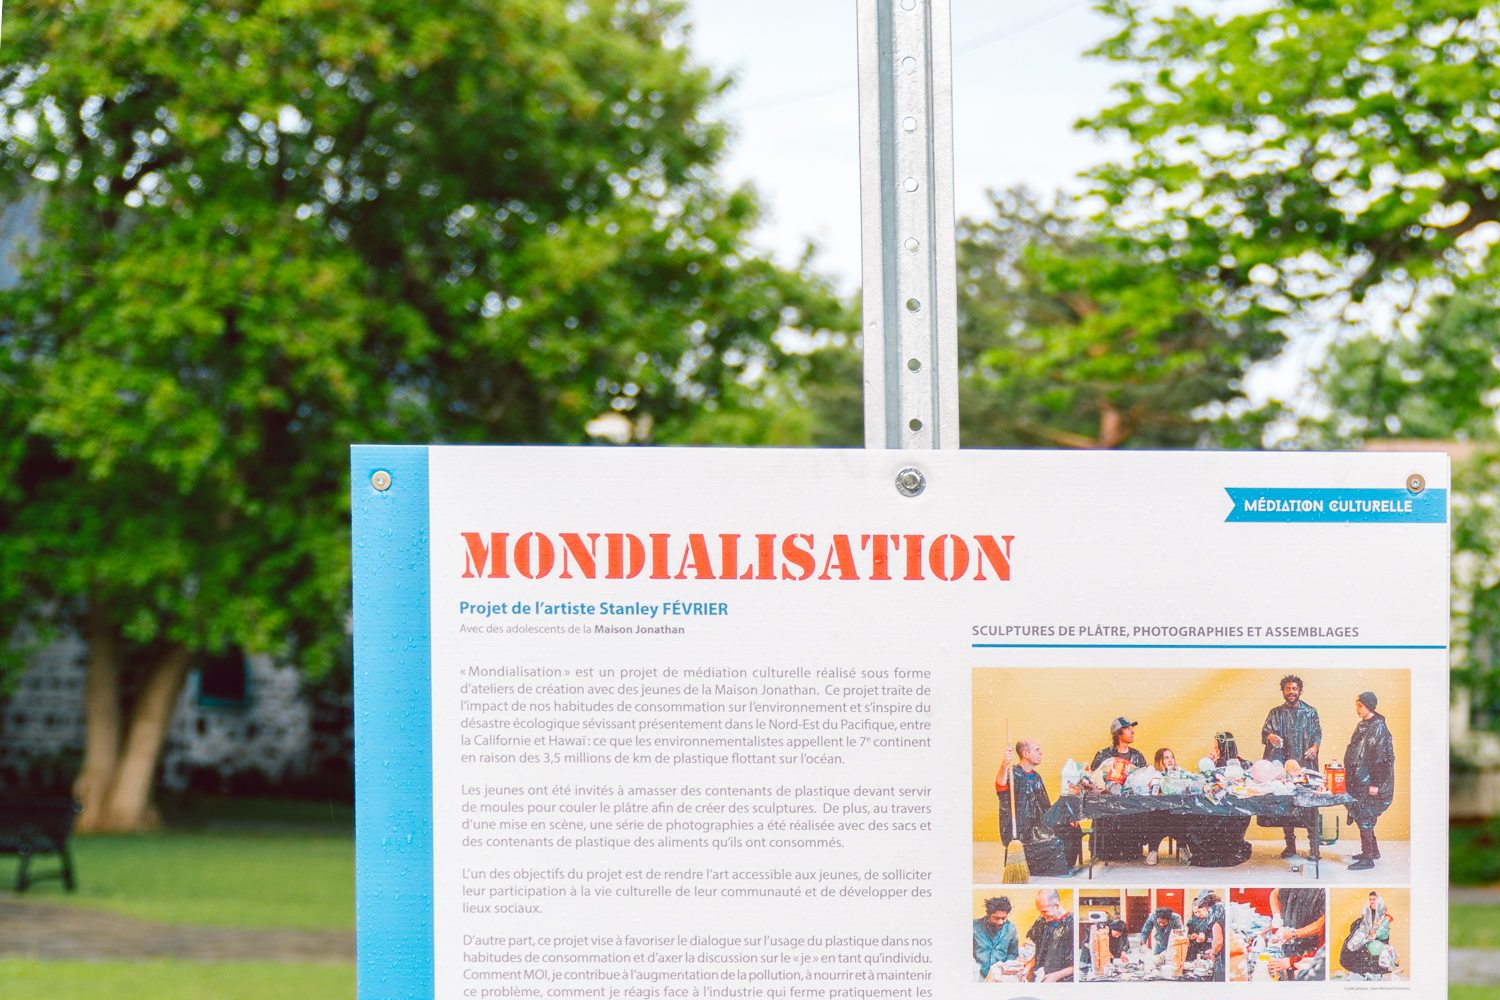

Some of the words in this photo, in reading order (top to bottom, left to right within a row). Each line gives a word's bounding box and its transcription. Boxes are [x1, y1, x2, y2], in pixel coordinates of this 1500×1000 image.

[1244, 497, 1324, 512] MÉDIATION
[1328, 501, 1413, 512] CULTURELLE
[460, 532, 1015, 581] MONDIALISATION
[460, 601, 507, 618] Projet
[511, 601, 531, 615] de
[536, 601, 595, 615] l’artiste
[600, 602, 659, 619] Stanley
[663, 600, 728, 615] FÉVRIER
[459, 624, 483, 633] Avec
[486, 624, 504, 633] des
[506, 624, 565, 633] adolescents
[567, 624, 581, 634] de
[583, 624, 591, 634] la
[594, 624, 633, 634] Maison
[635, 625, 685, 634] Jonathan
[972, 625, 1055, 636] SCULPTURES
[1058, 626, 1075, 636] DE
[1079, 624, 1130, 638] PLÂTRE,
[1133, 626, 1244, 637] PHOTOGRAPHIES
[1247, 626, 1262, 637] ET
[1265, 626, 1359, 637] ASSEMBLAGES
[460, 683, 515, 694] d’ateliers
[517, 683, 533, 694] de
[535, 683, 584, 694] création
[587, 686, 615, 695] avec
[617, 683, 639, 695] des
[640, 684, 681, 698] jeunes
[683, 684, 699, 695] de
[702, 684, 712, 695] la
[715, 684, 758, 695] Maison
[761, 684, 819, 695] Jonathan.
[825, 684, 840, 696] Ce
[843, 685, 879, 698] projet
[881, 685, 913, 696] traite
[915, 684, 931, 696] de
[461, 700, 508, 714] l’impact
[511, 700, 527, 711] de
[529, 703, 551, 712] nos
[554, 700, 614, 712] habitudes
[616, 701, 632, 712] de
[634, 701, 725, 712] consommation
[728, 704, 747, 712] sur
[749, 701, 847, 713] l’environnement
[850, 703, 862, 713] et
[864, 702, 913, 715] s’inspire
[915, 702, 931, 713] du
[462, 784, 481, 795] Les
[484, 785, 524, 798] jeunes
[527, 786, 548, 795] ont
[552, 784, 571, 796] été
[575, 785, 614, 796] invités
[617, 785, 624, 796] à
[628, 787, 677, 796] amasser
[680, 785, 702, 796] des
[705, 786, 772, 796] contenants
[776, 785, 791, 796] de
[795, 785, 850, 799] plastique
[853, 785, 895, 797] devant
[899, 786, 932, 797] servir
[462, 835, 483, 847] des
[486, 837, 554, 847] contenants
[556, 836, 572, 847] de
[575, 836, 631, 850] plastique
[633, 836, 655, 847] des
[657, 836, 709, 847] aliments
[712, 836, 743, 850] qu’ils
[745, 838, 766, 848] ont
[769, 837, 844, 848] consommés.
[462, 885, 486, 896] leur
[489, 886, 566, 899] participation
[570, 885, 577, 896] à
[581, 885, 591, 896] la
[594, 886, 612, 896] vie
[615, 885, 672, 897] culturelle
[675, 885, 691, 897] de
[694, 885, 718, 897] leur
[721, 886, 802, 897] communauté
[805, 887, 817, 897] et
[820, 886, 836, 897] de
[839, 886, 908, 900] développer
[911, 886, 932, 897] des
[463, 988, 477, 997] ce
[481, 986, 543, 999] problème,
[547, 987, 605, 997] comment
[608, 986, 620, 1000] je
[624, 986, 660, 1000] réagis
[664, 985, 689, 997] face
[692, 986, 699, 997] à
[703, 986, 763, 997] l’industrie
[766, 986, 786, 1000] qui
[790, 986, 825, 997] ferme
[829, 987, 912, 1000] pratiquement
[916, 986, 932, 998] les
